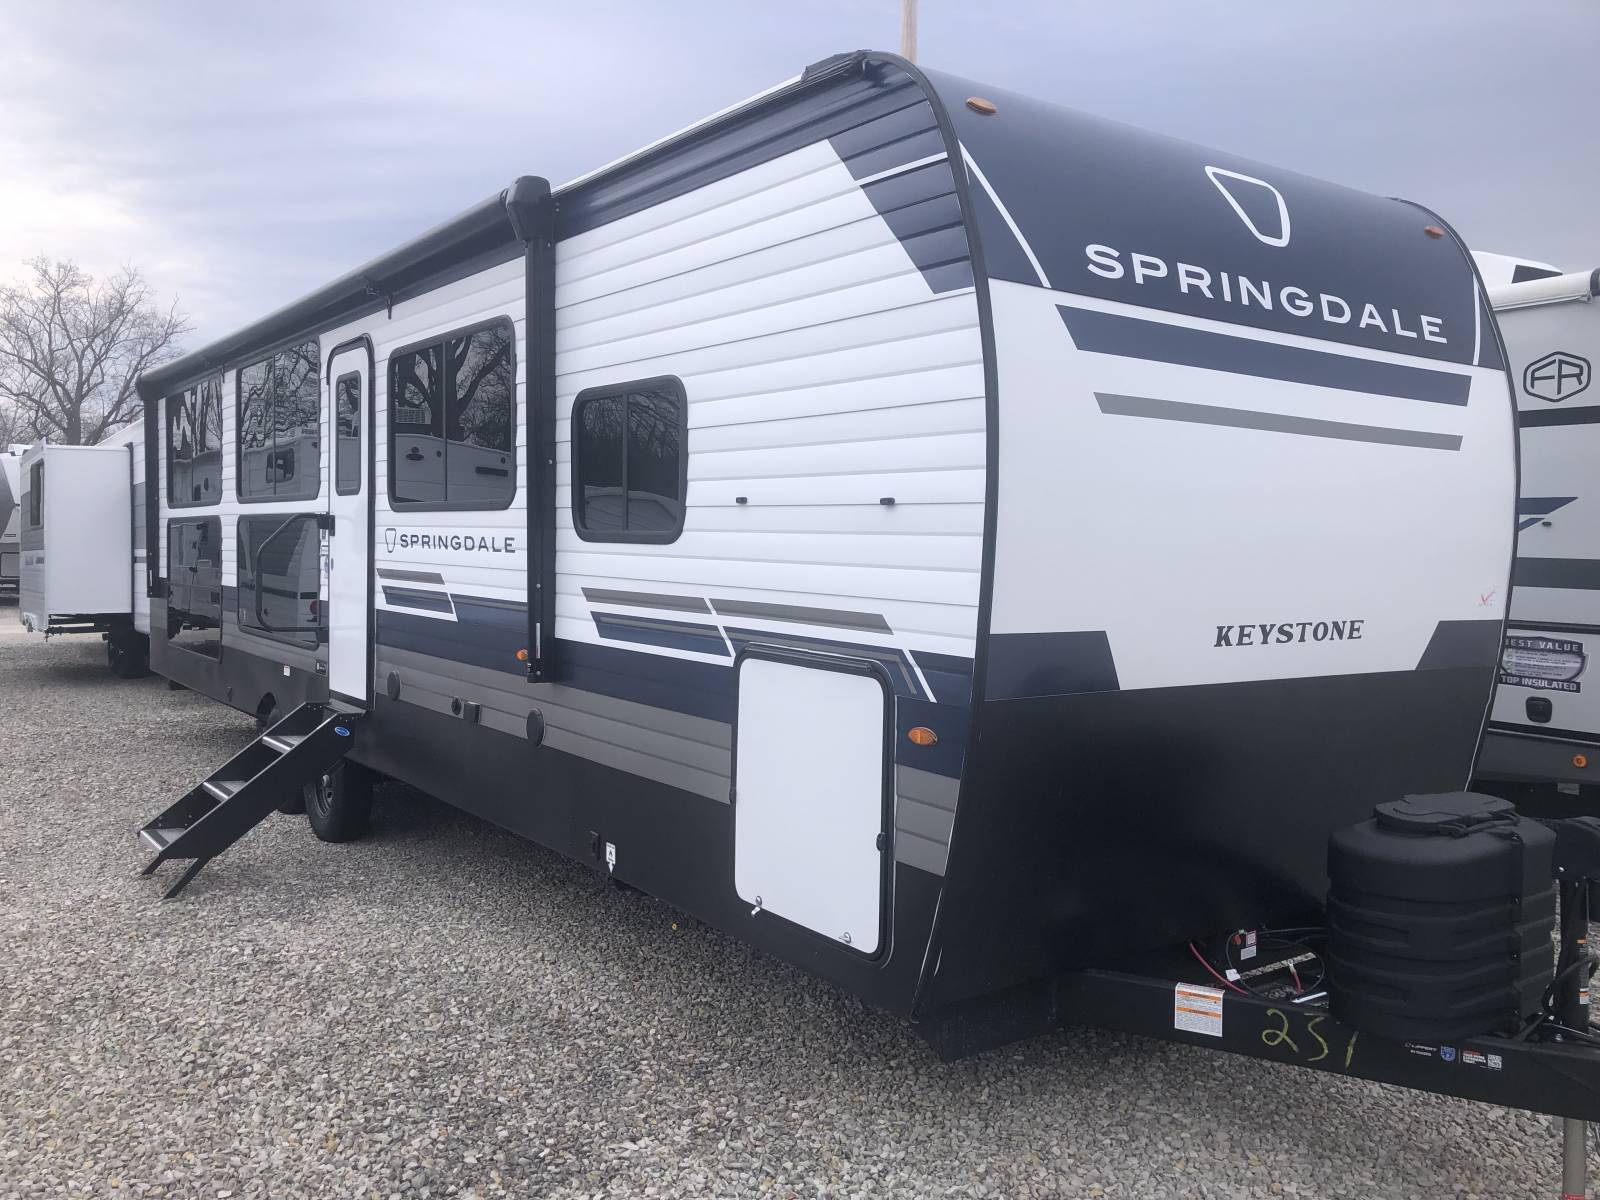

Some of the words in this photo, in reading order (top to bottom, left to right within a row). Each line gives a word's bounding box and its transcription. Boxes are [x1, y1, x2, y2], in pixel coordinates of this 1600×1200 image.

[1085, 243, 1448, 345] SPRINGDALE
[400, 533, 516, 554] SPRINGDALE
[1214, 619, 1365, 648] KEYSTONE
[1539, 640, 1579, 651] VALUE
[1522, 677, 1577, 690] INSULATED
